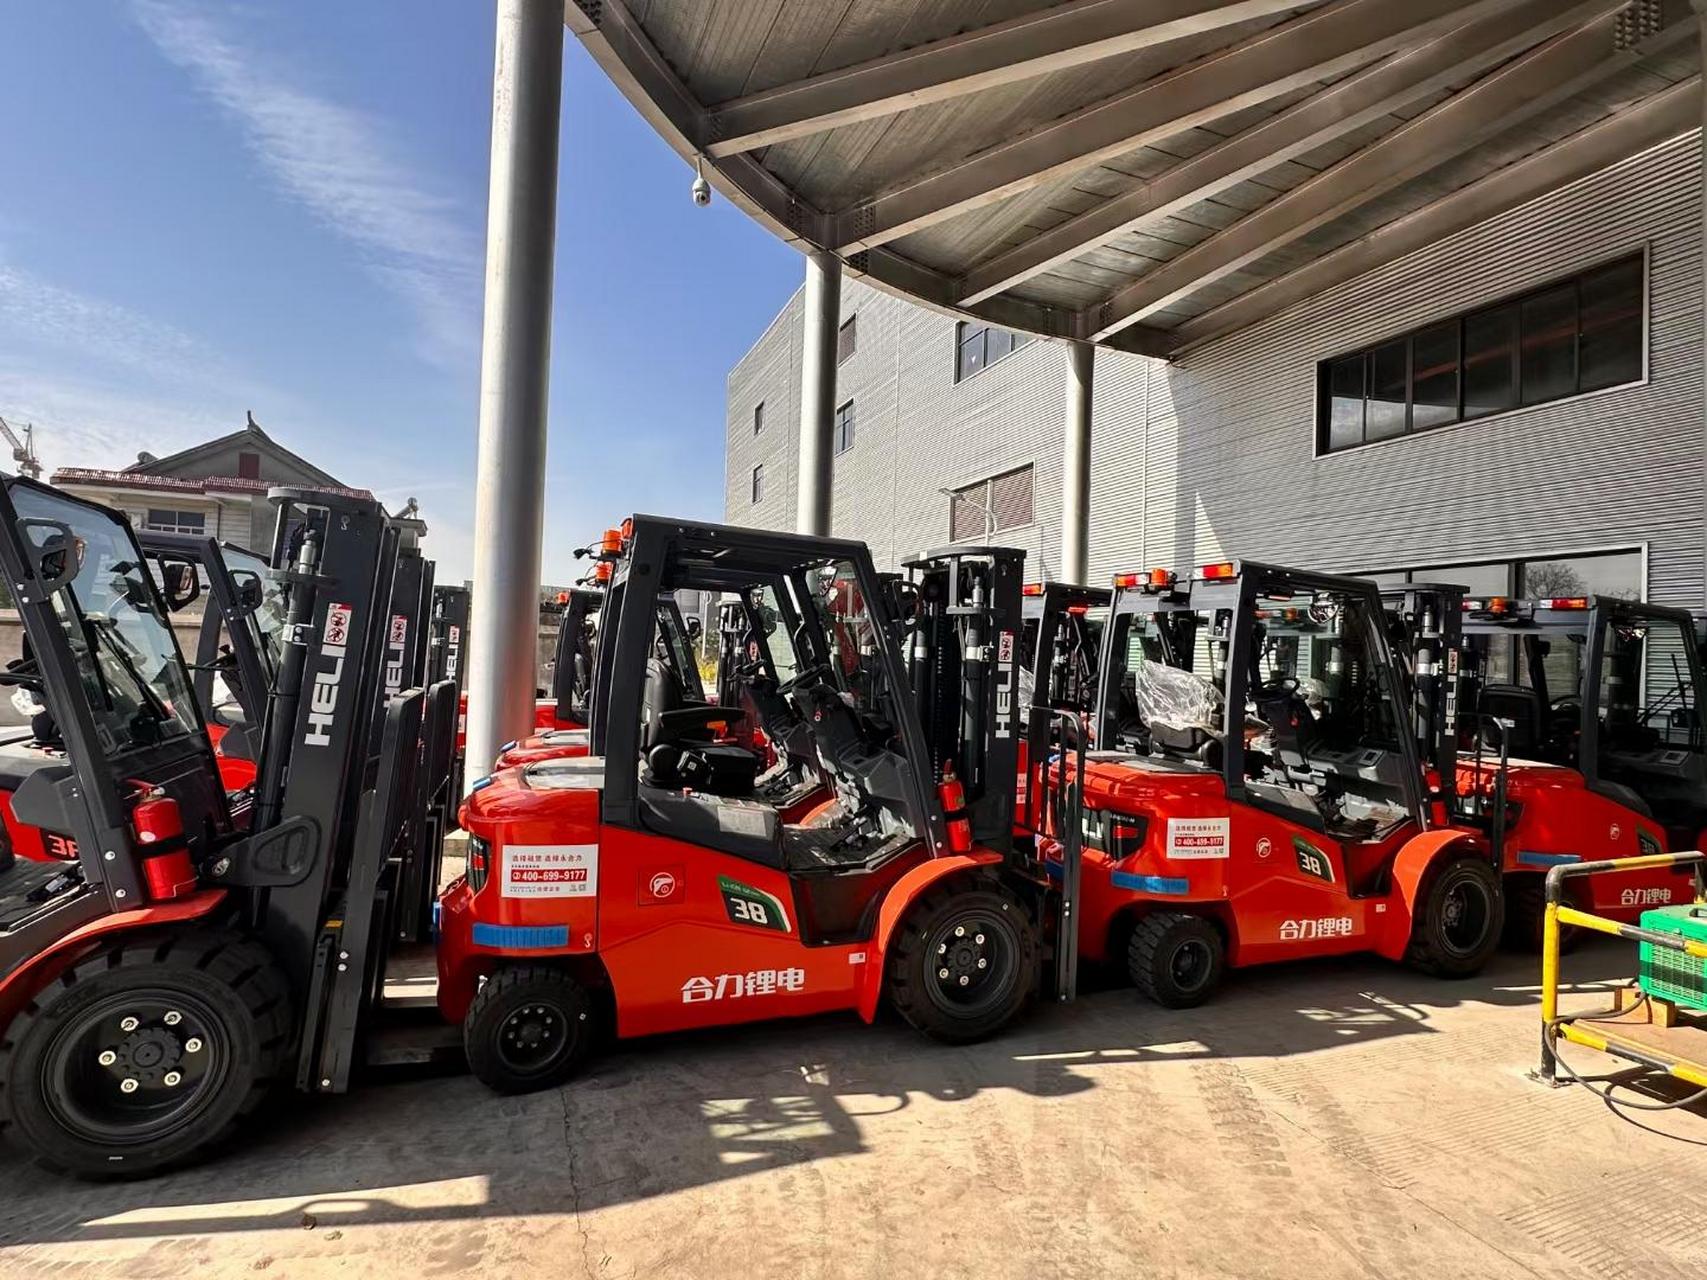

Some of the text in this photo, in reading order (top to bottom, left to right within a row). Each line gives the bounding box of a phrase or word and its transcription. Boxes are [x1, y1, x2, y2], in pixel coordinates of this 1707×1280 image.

[304, 644, 347, 746] HELI
[995, 663, 1012, 738] HELI
[1444, 675, 1457, 736] HELI
[522, 870, 586, 881] 400-699-9177
[1299, 852, 1321, 876] 38
[1621, 888, 1672, 905] 合力锂电
[730, 897, 768, 924] 38
[1279, 917, 1353, 940] 合力锂电
[680, 967, 805, 1004] 合力锂电
